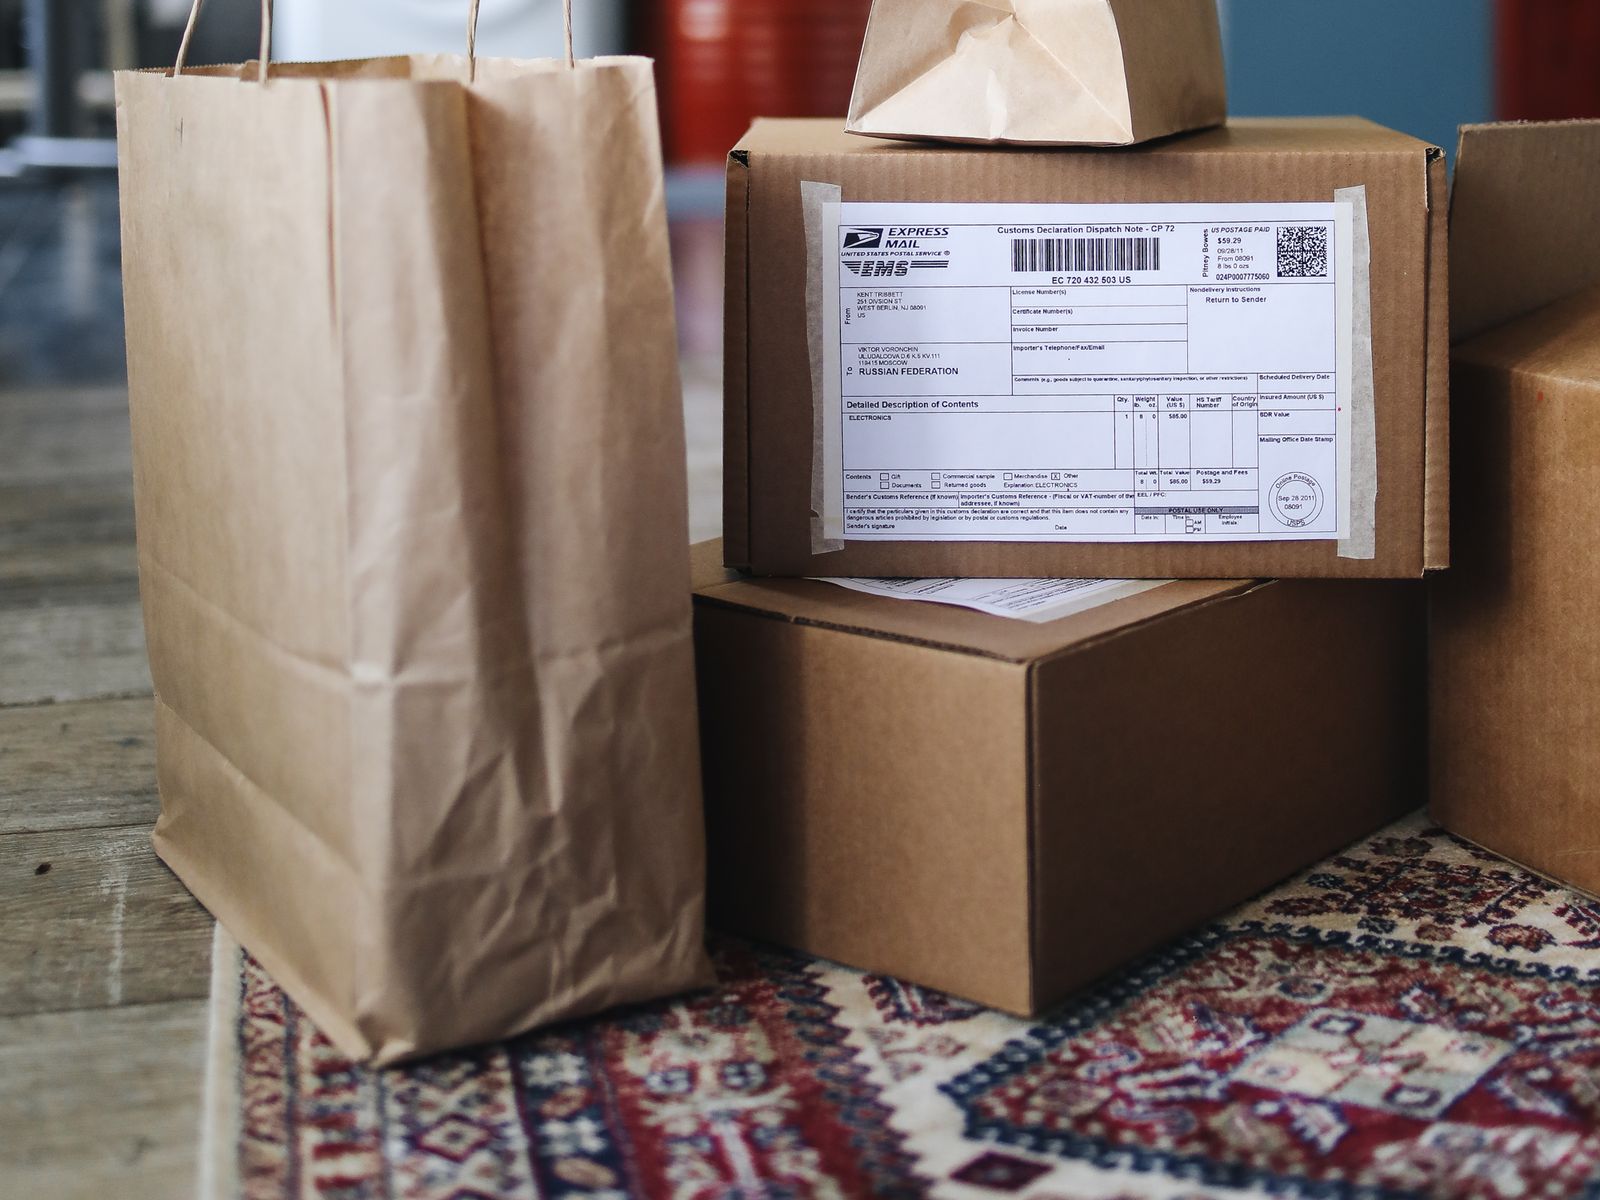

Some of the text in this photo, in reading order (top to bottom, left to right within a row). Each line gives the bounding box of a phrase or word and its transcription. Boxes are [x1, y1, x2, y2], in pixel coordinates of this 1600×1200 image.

[888, 228, 949, 236] EXPRESS
[1086, 226, 1121, 234] Dispatch
[885, 240, 920, 248] MAIL
[861, 261, 908, 276] EMS
[847, 367, 852, 376] To
[901, 367, 958, 375] FEDERATION
[882, 401, 928, 409] Description
[1276, 474, 1315, 488] Online Postage
